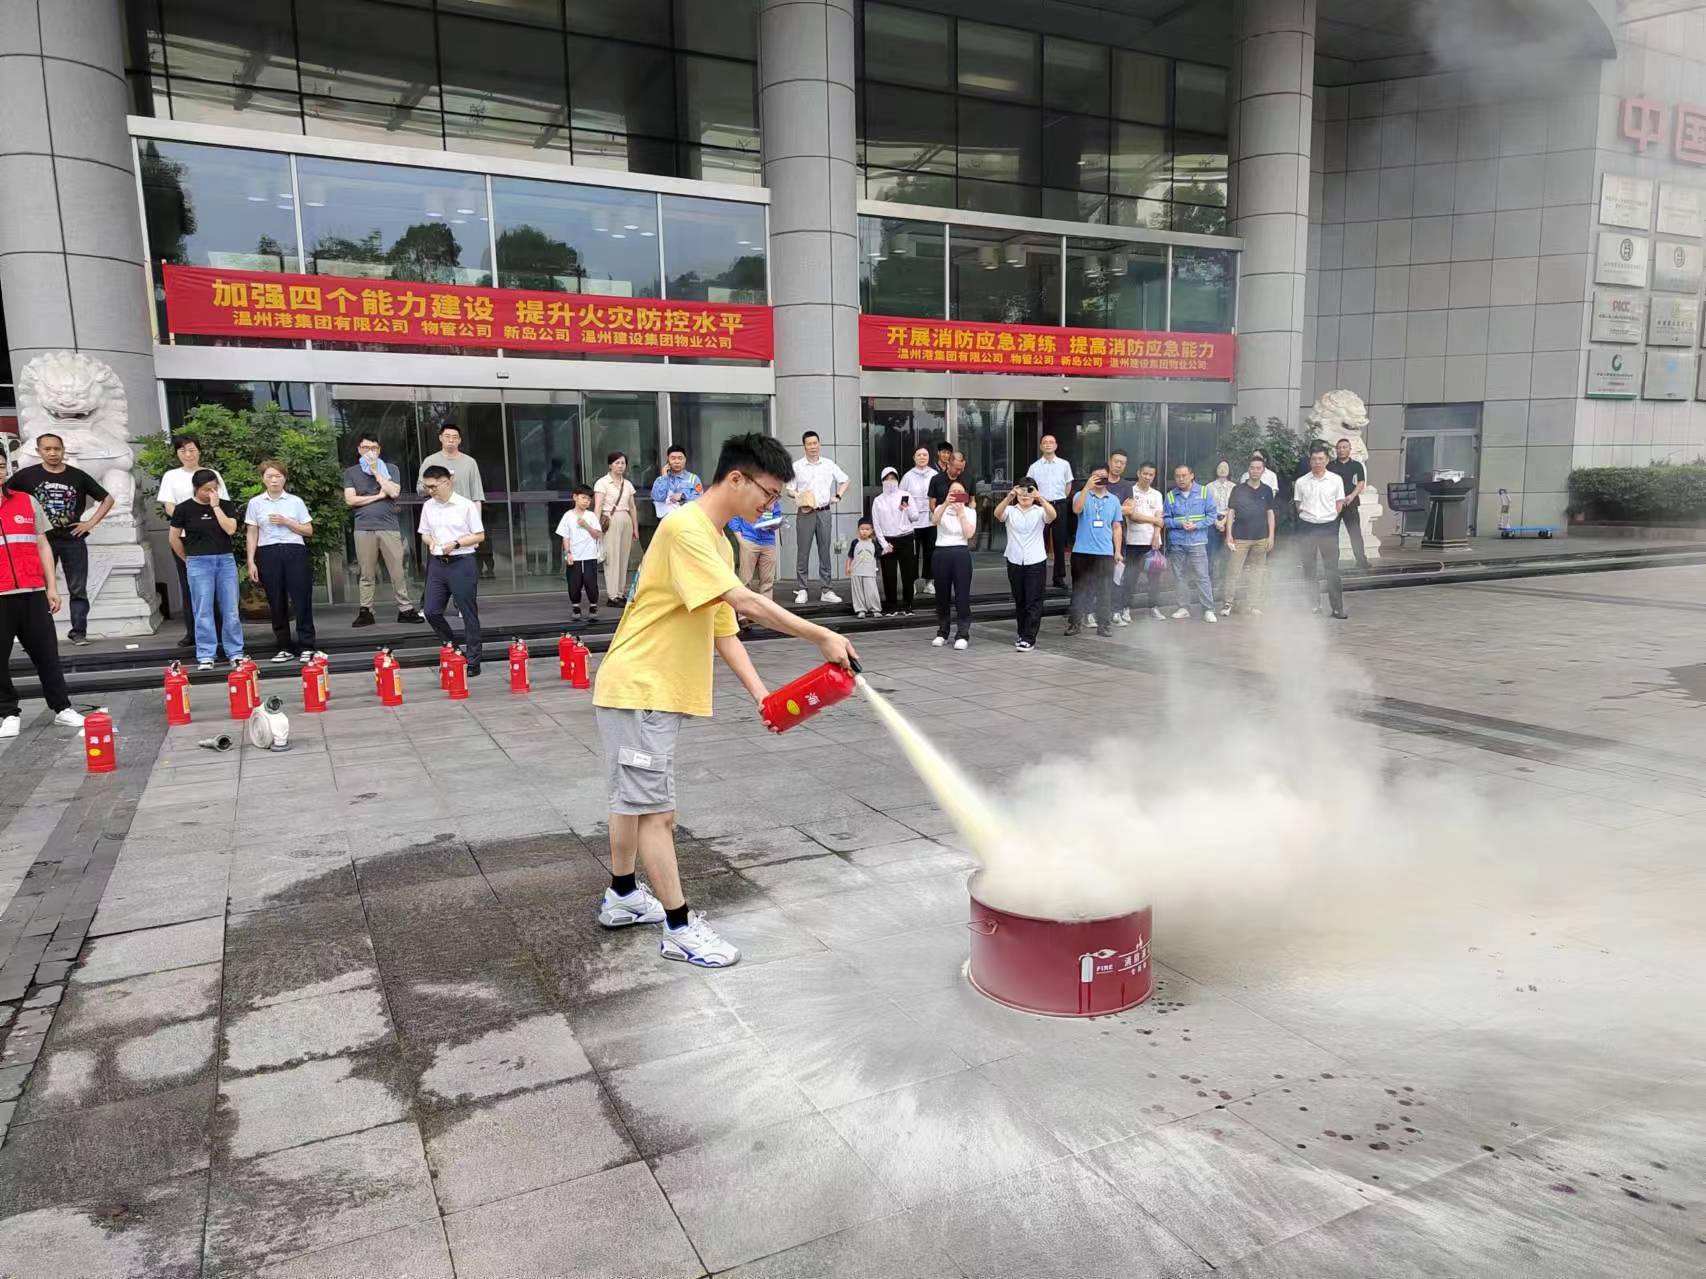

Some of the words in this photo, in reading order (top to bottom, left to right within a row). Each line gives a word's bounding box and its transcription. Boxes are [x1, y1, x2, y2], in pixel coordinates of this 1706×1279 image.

[212, 279, 494, 321] 加强四个能力建设
[516, 300, 743, 335] 提升火灾防控水平
[233, 311, 408, 333] 温州港集团有限公司
[421, 320, 492, 338] 物管公司
[504, 325, 569, 342] 新岛公司
[582, 329, 731, 349] 温州建设集团物业公司
[887, 325, 1056, 353] 开展消防应急演练
[1070, 335, 1214, 359] 提高消防应急能力
[898, 348, 1003, 364] 温州港集团有限公司
[1011, 353, 1054, 366] 物管公司
[1061, 356, 1102, 368] 新岛公司
[1096, 964, 1113, 972] FIRE
